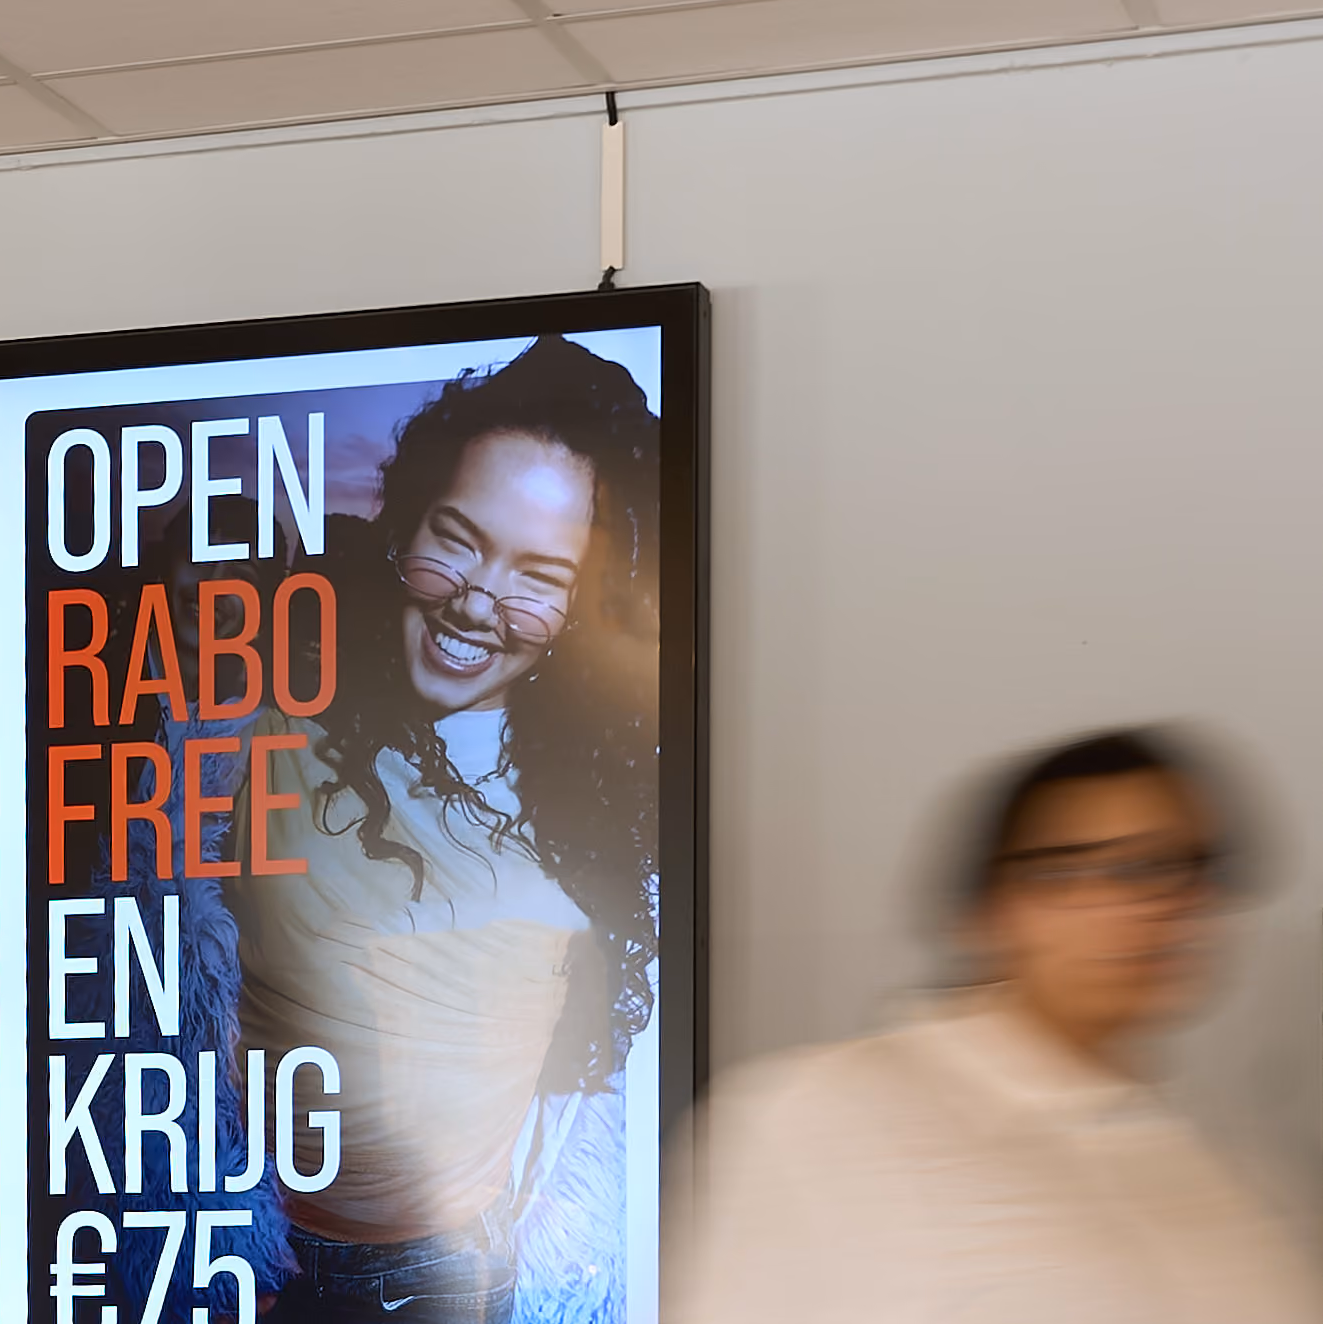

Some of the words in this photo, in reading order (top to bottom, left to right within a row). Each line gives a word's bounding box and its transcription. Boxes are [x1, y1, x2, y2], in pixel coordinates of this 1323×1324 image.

[47, 411, 326, 573] OPEN
[47, 572, 338, 730] RABO
[47, 733, 309, 885] FREE
[47, 894, 181, 1041] EN
[48, 1045, 342, 1196] KRIJG
